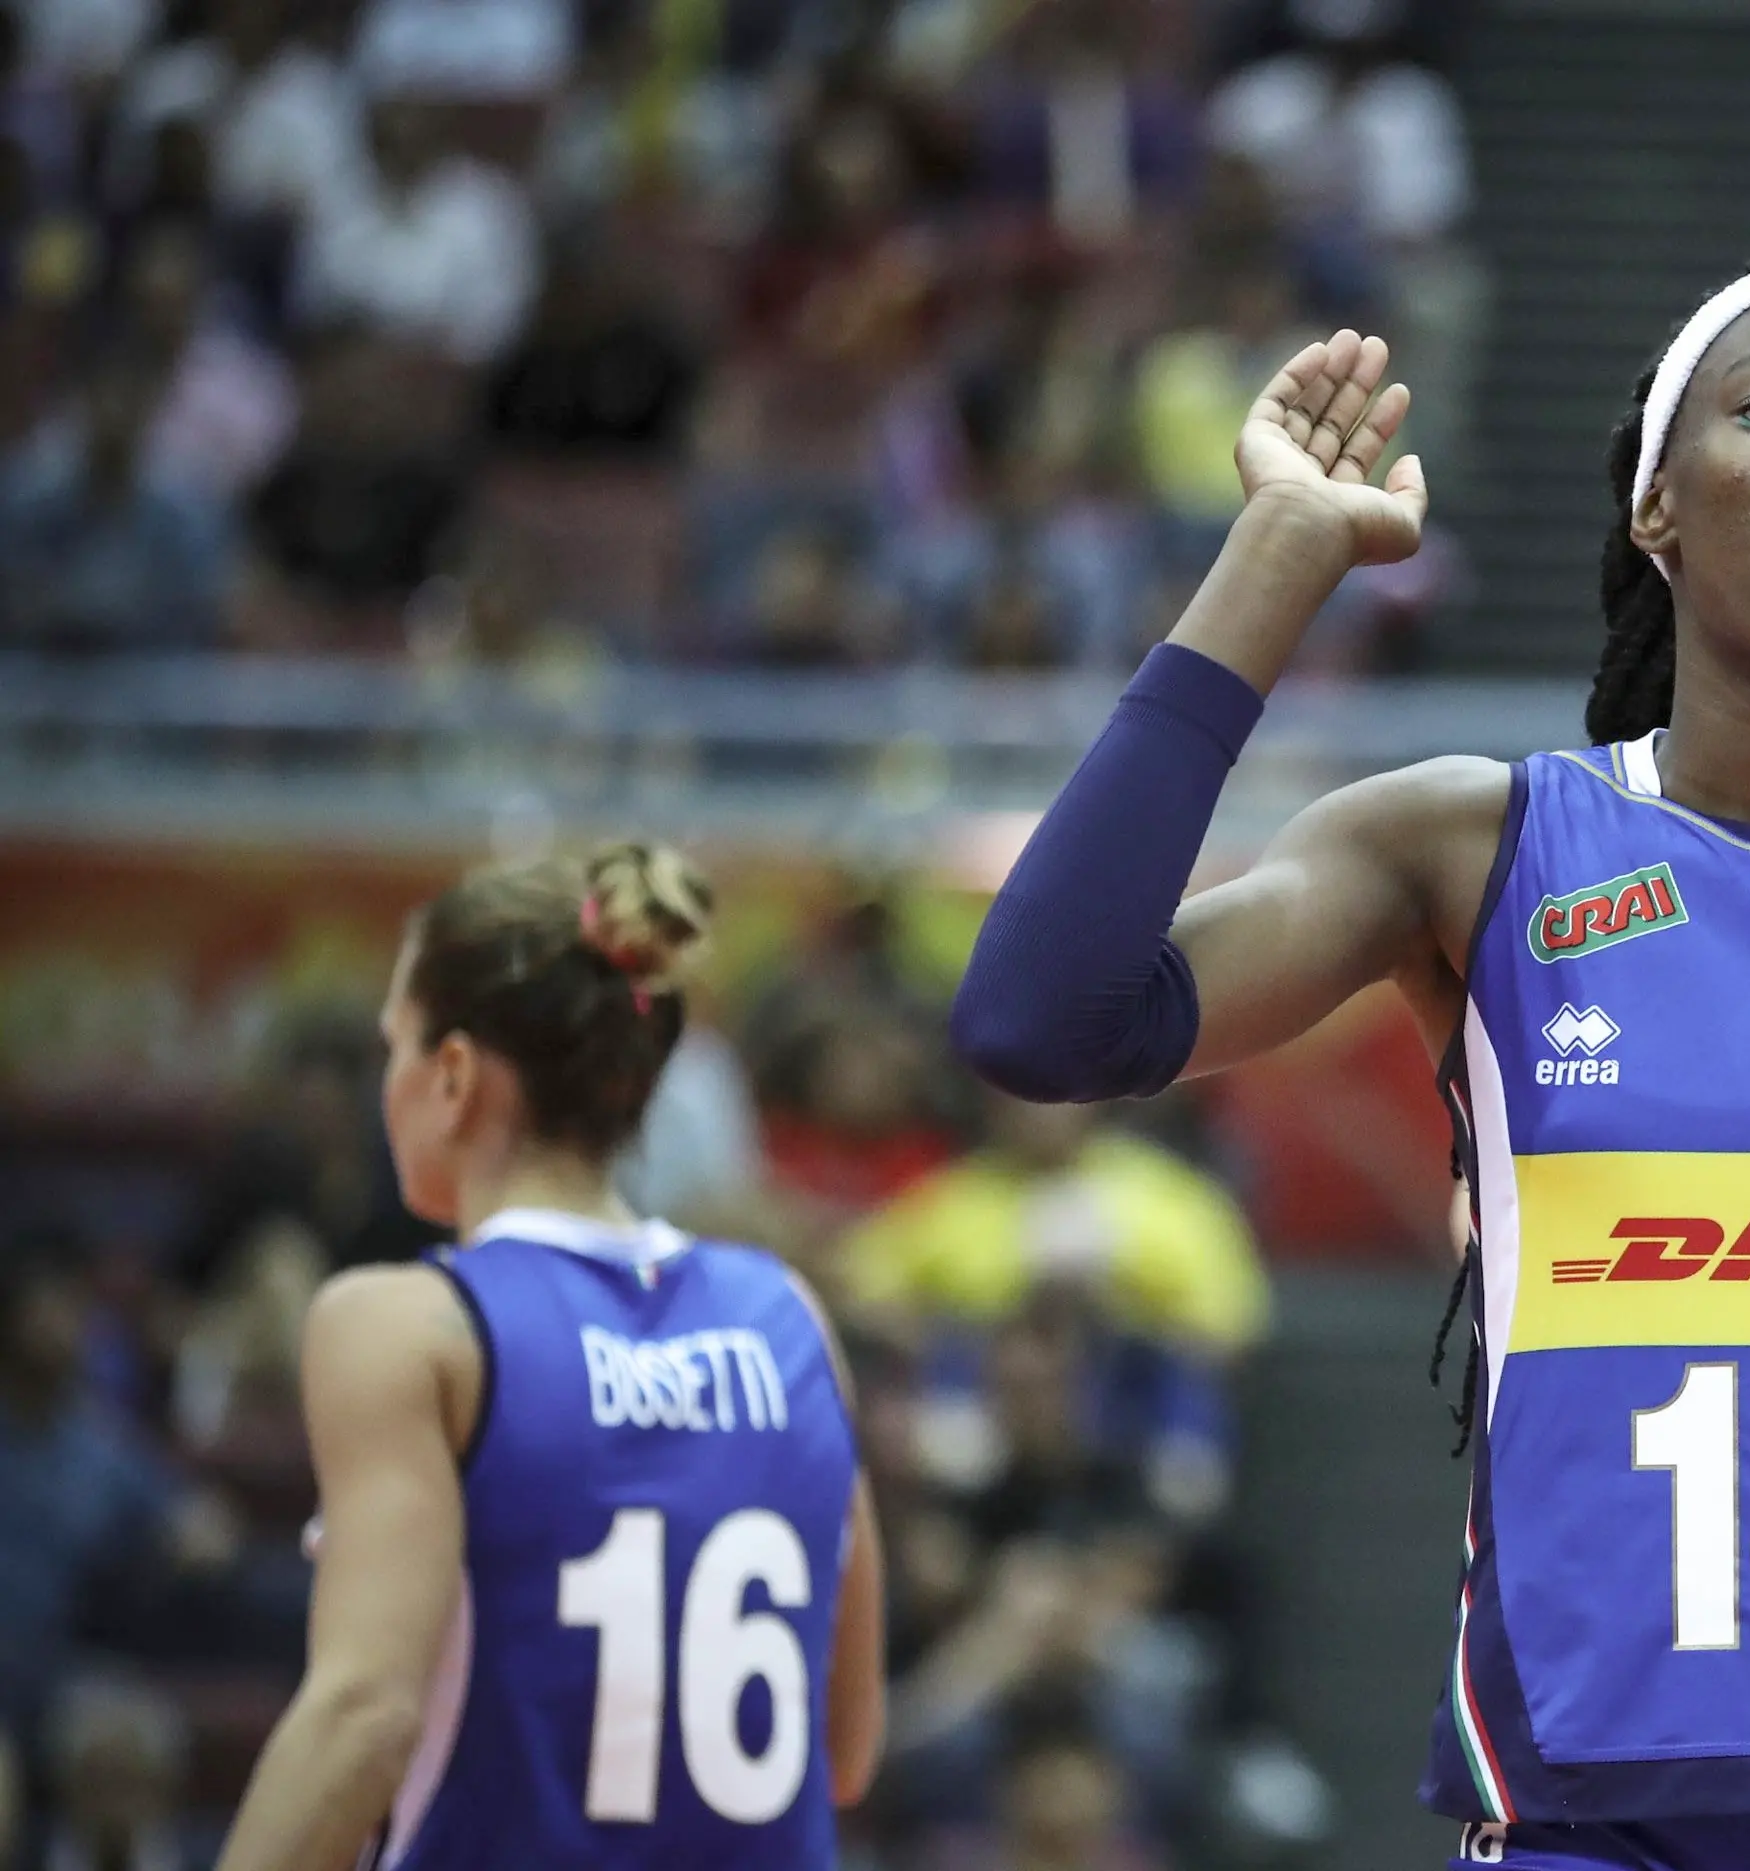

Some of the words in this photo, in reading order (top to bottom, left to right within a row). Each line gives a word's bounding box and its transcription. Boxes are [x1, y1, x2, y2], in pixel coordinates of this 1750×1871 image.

[1540, 877, 1676, 950] CRAI
[579, 1324, 790, 1432] BOSETTI
[556, 1507, 813, 1826] 16
